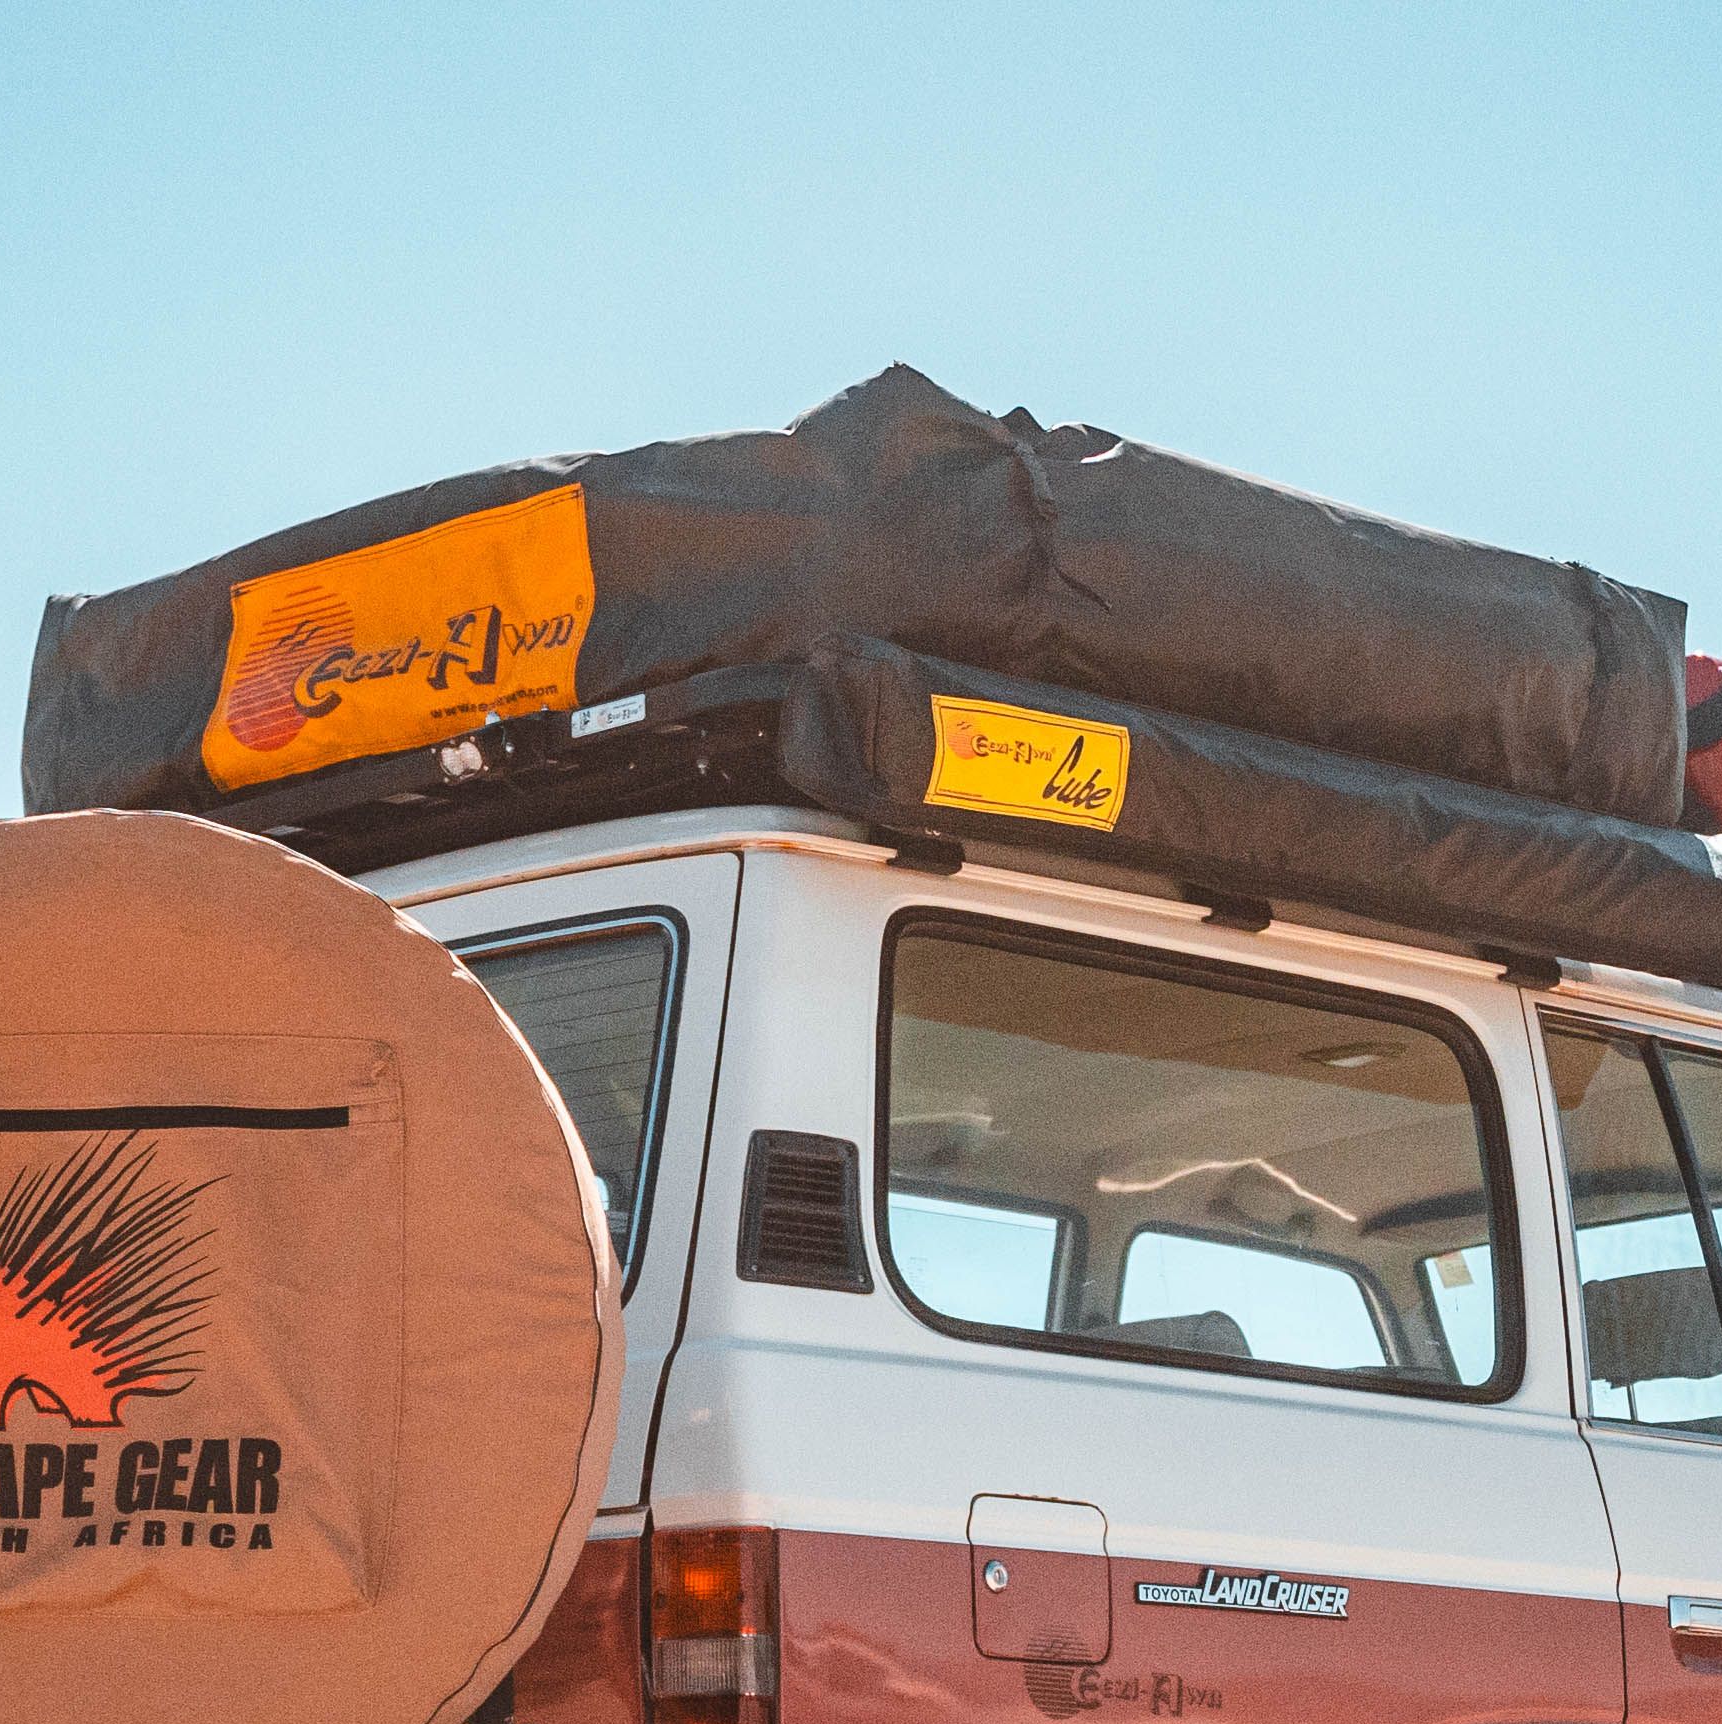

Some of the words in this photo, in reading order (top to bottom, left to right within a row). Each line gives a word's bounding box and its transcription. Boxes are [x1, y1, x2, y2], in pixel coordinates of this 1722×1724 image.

[1042, 734, 1113, 810] Cube
[115, 1437, 282, 1515] GEAR
[73, 1520, 274, 1551] AFRICA
[1142, 1586, 1198, 1603] TOYOTA
